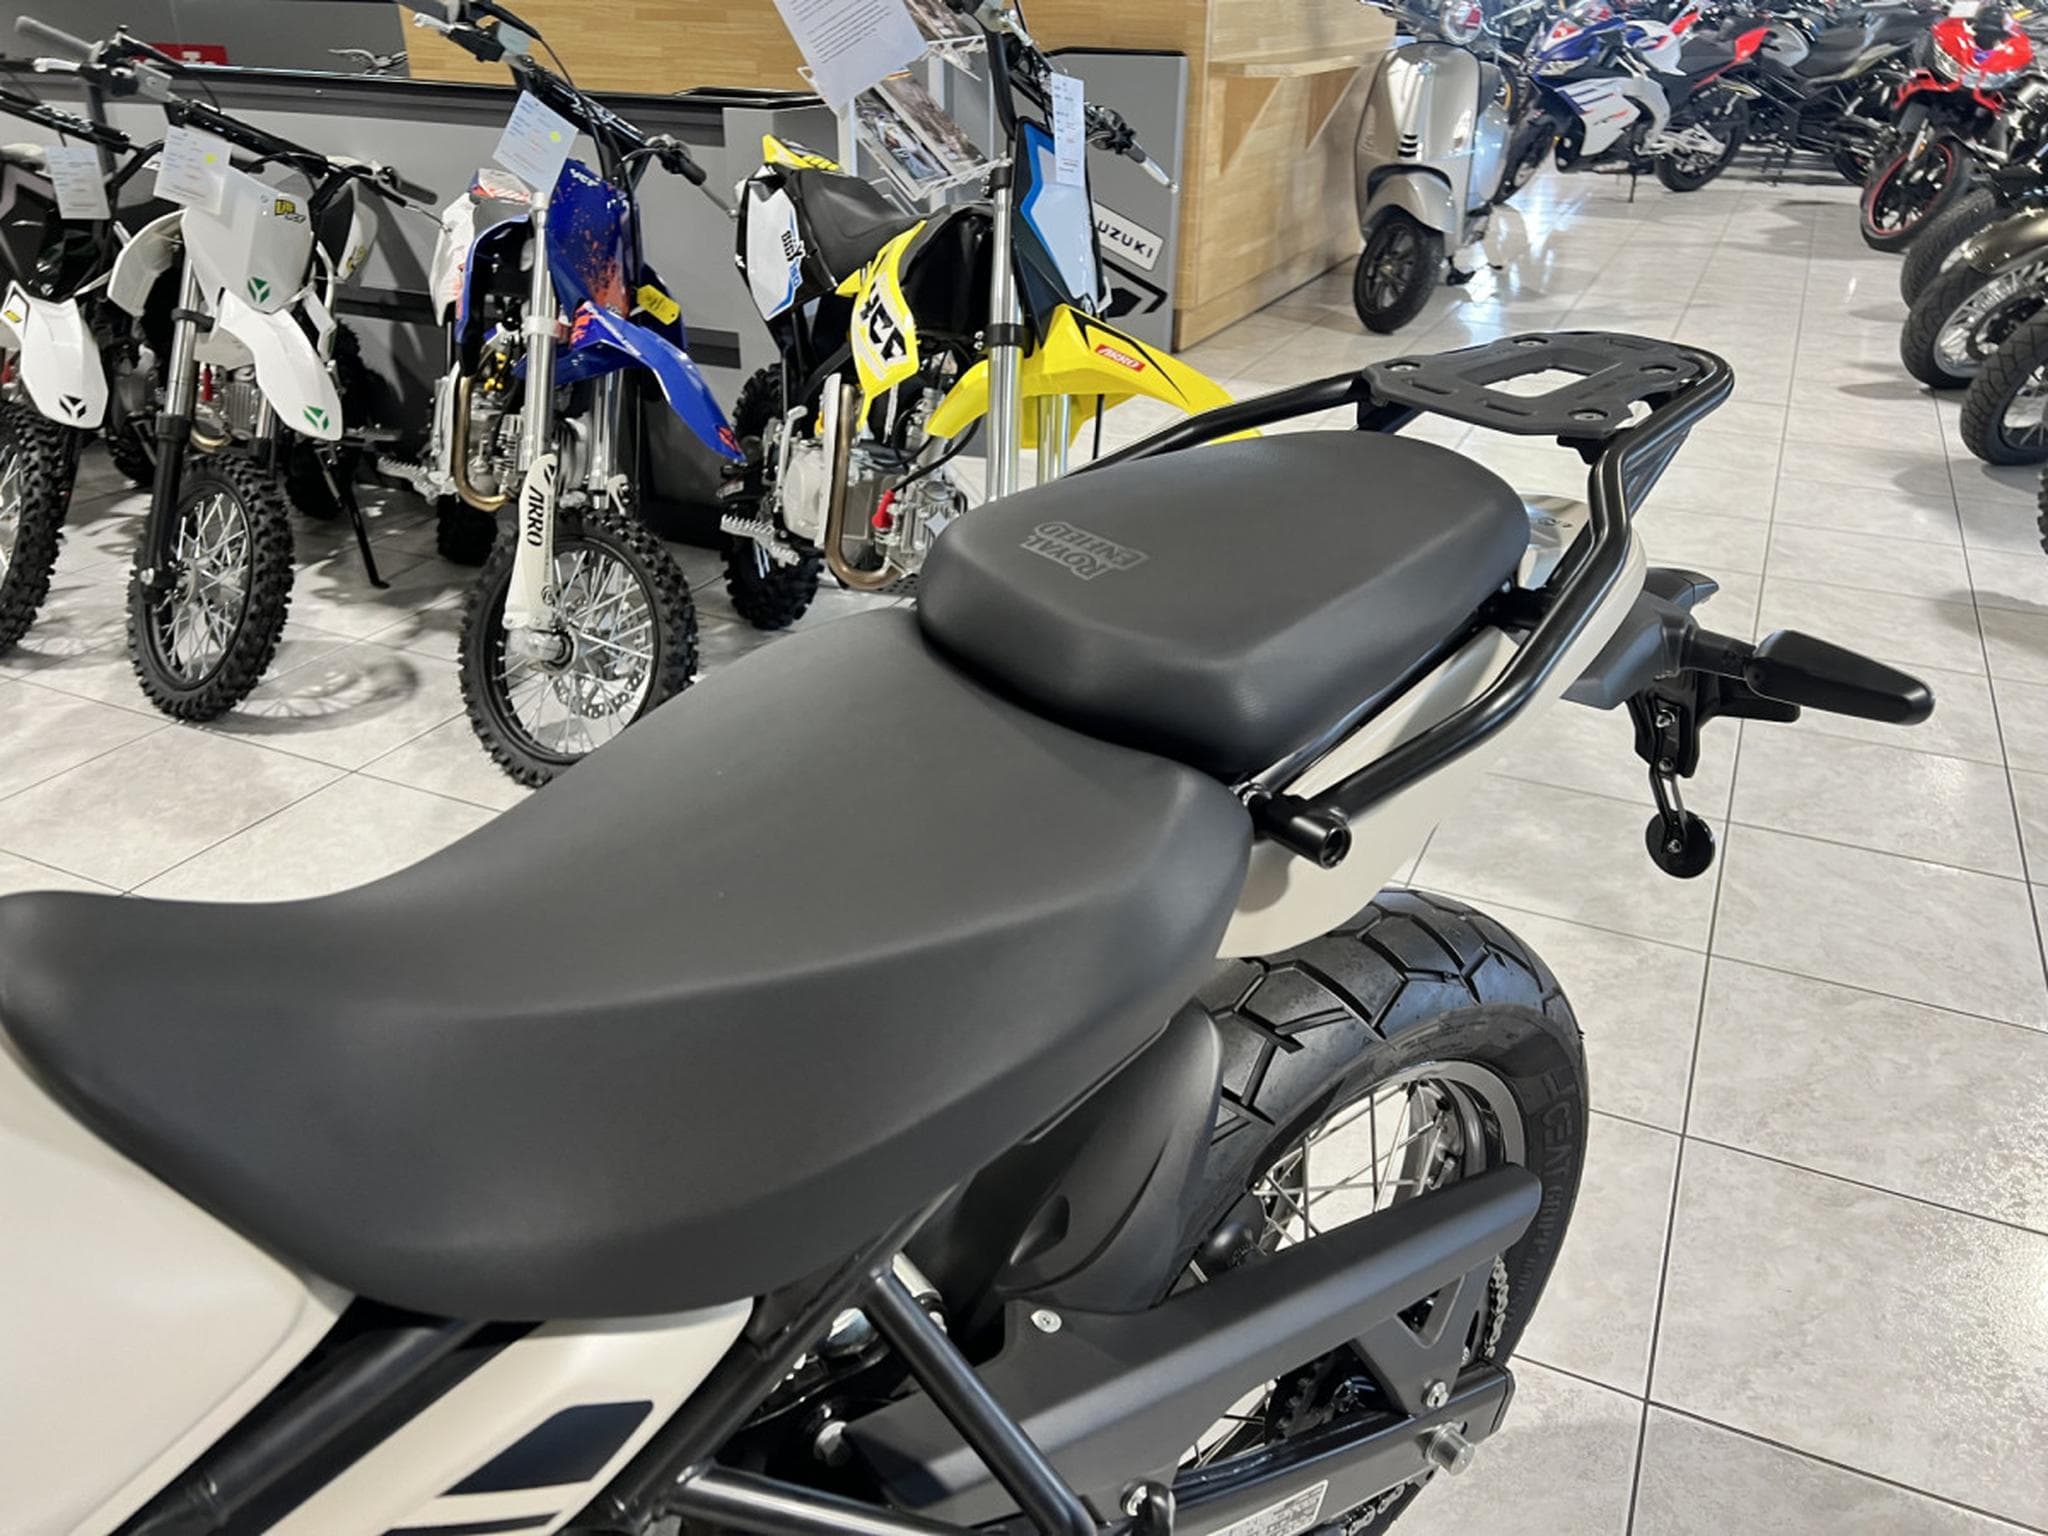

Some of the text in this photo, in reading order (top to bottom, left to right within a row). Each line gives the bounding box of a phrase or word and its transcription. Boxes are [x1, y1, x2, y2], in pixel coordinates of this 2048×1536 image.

[1096, 220, 1154, 259] UZUKI
[859, 282, 907, 363] YCF
[526, 485, 545, 548] ARRO
[1026, 535, 1106, 577] ROYAL
[1038, 523, 1144, 567] ENFIELD
